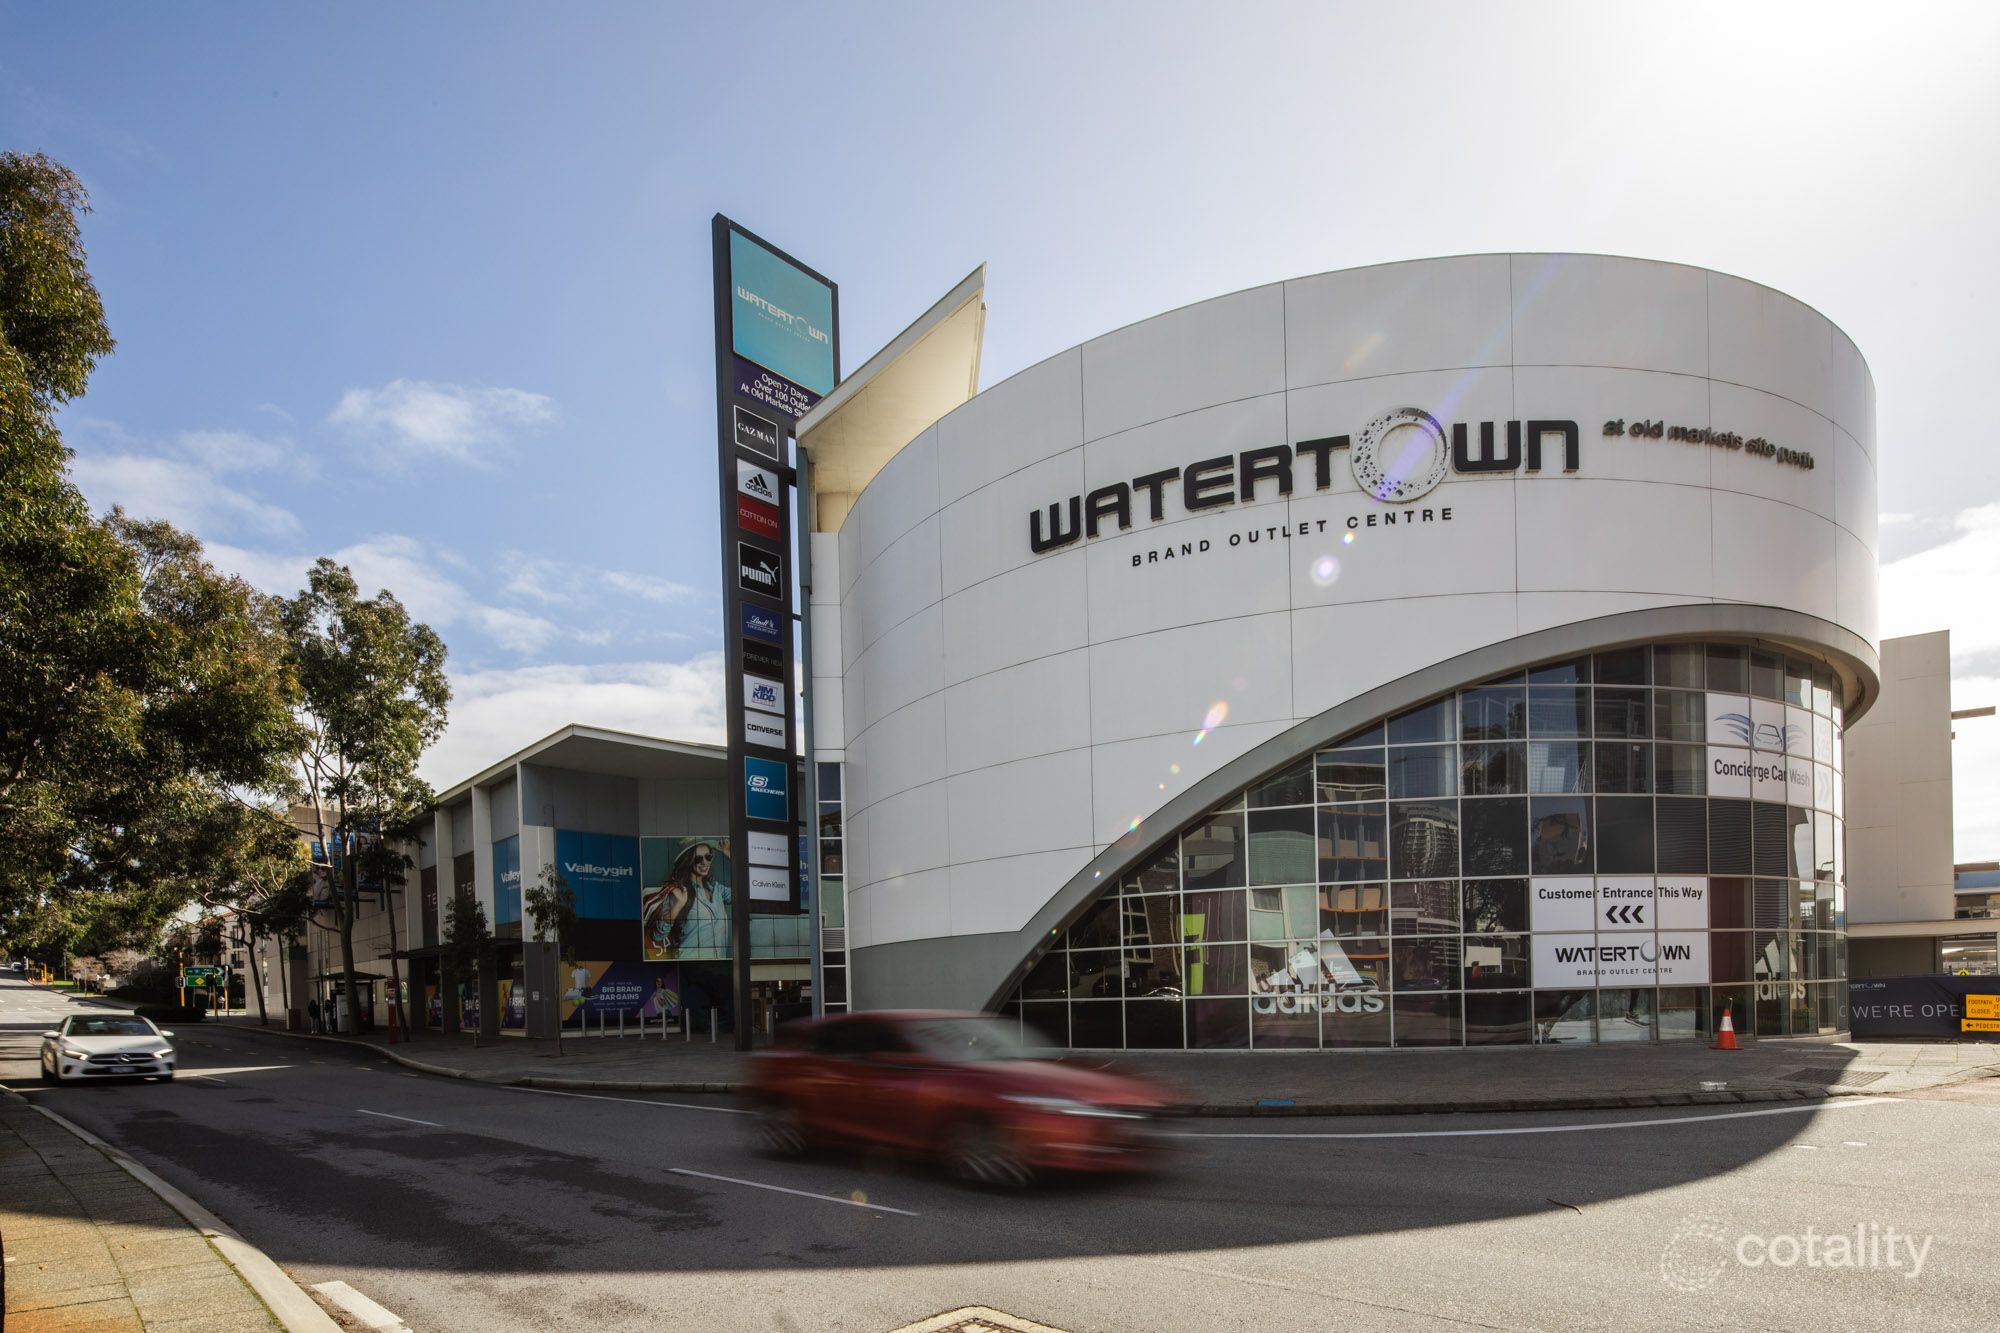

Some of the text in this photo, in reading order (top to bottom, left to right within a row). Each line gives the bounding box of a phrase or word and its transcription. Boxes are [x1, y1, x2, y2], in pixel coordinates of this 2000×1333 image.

[737, 285, 829, 345] WATERTOWN
[741, 383, 750, 394] At
[751, 387, 764, 400] Old
[765, 395, 793, 414] Markets
[754, 380, 773, 394] Over
[775, 390, 789, 402] 100
[761, 373, 808, 403] Open 7 Days
[737, 422, 776, 446] GAZMAN
[1602, 418, 1815, 470] at old markets site perth
[745, 482, 773, 499] adidas
[1029, 406, 1580, 555] WATERTOWN
[740, 508, 778, 529] COTTON ON
[1132, 508, 1453, 567] BRAND OUTLET CENTRE
[741, 564, 772, 586] PUMA
[752, 690, 776, 703] KIDD
[755, 685, 774, 696] JIM
[747, 723, 783, 737] CONVERSE
[1714, 758, 1770, 783] Concierge
[1788, 767, 1811, 787] Wash
[750, 787, 785, 796] SKECHERS
[564, 862, 633, 877] Valleygirl
[752, 879, 787, 889] Calvin Klein
[1538, 886, 1703, 900] Customer Entrance This Way
[1554, 940, 1691, 963] WATERTOWN
[600, 993, 639, 1001] BARGAINS
[1253, 983, 1385, 1015] adidas
[1852, 1005, 1914, 1018] WE'RE
[1921, 1004, 1962, 1017] OPE
